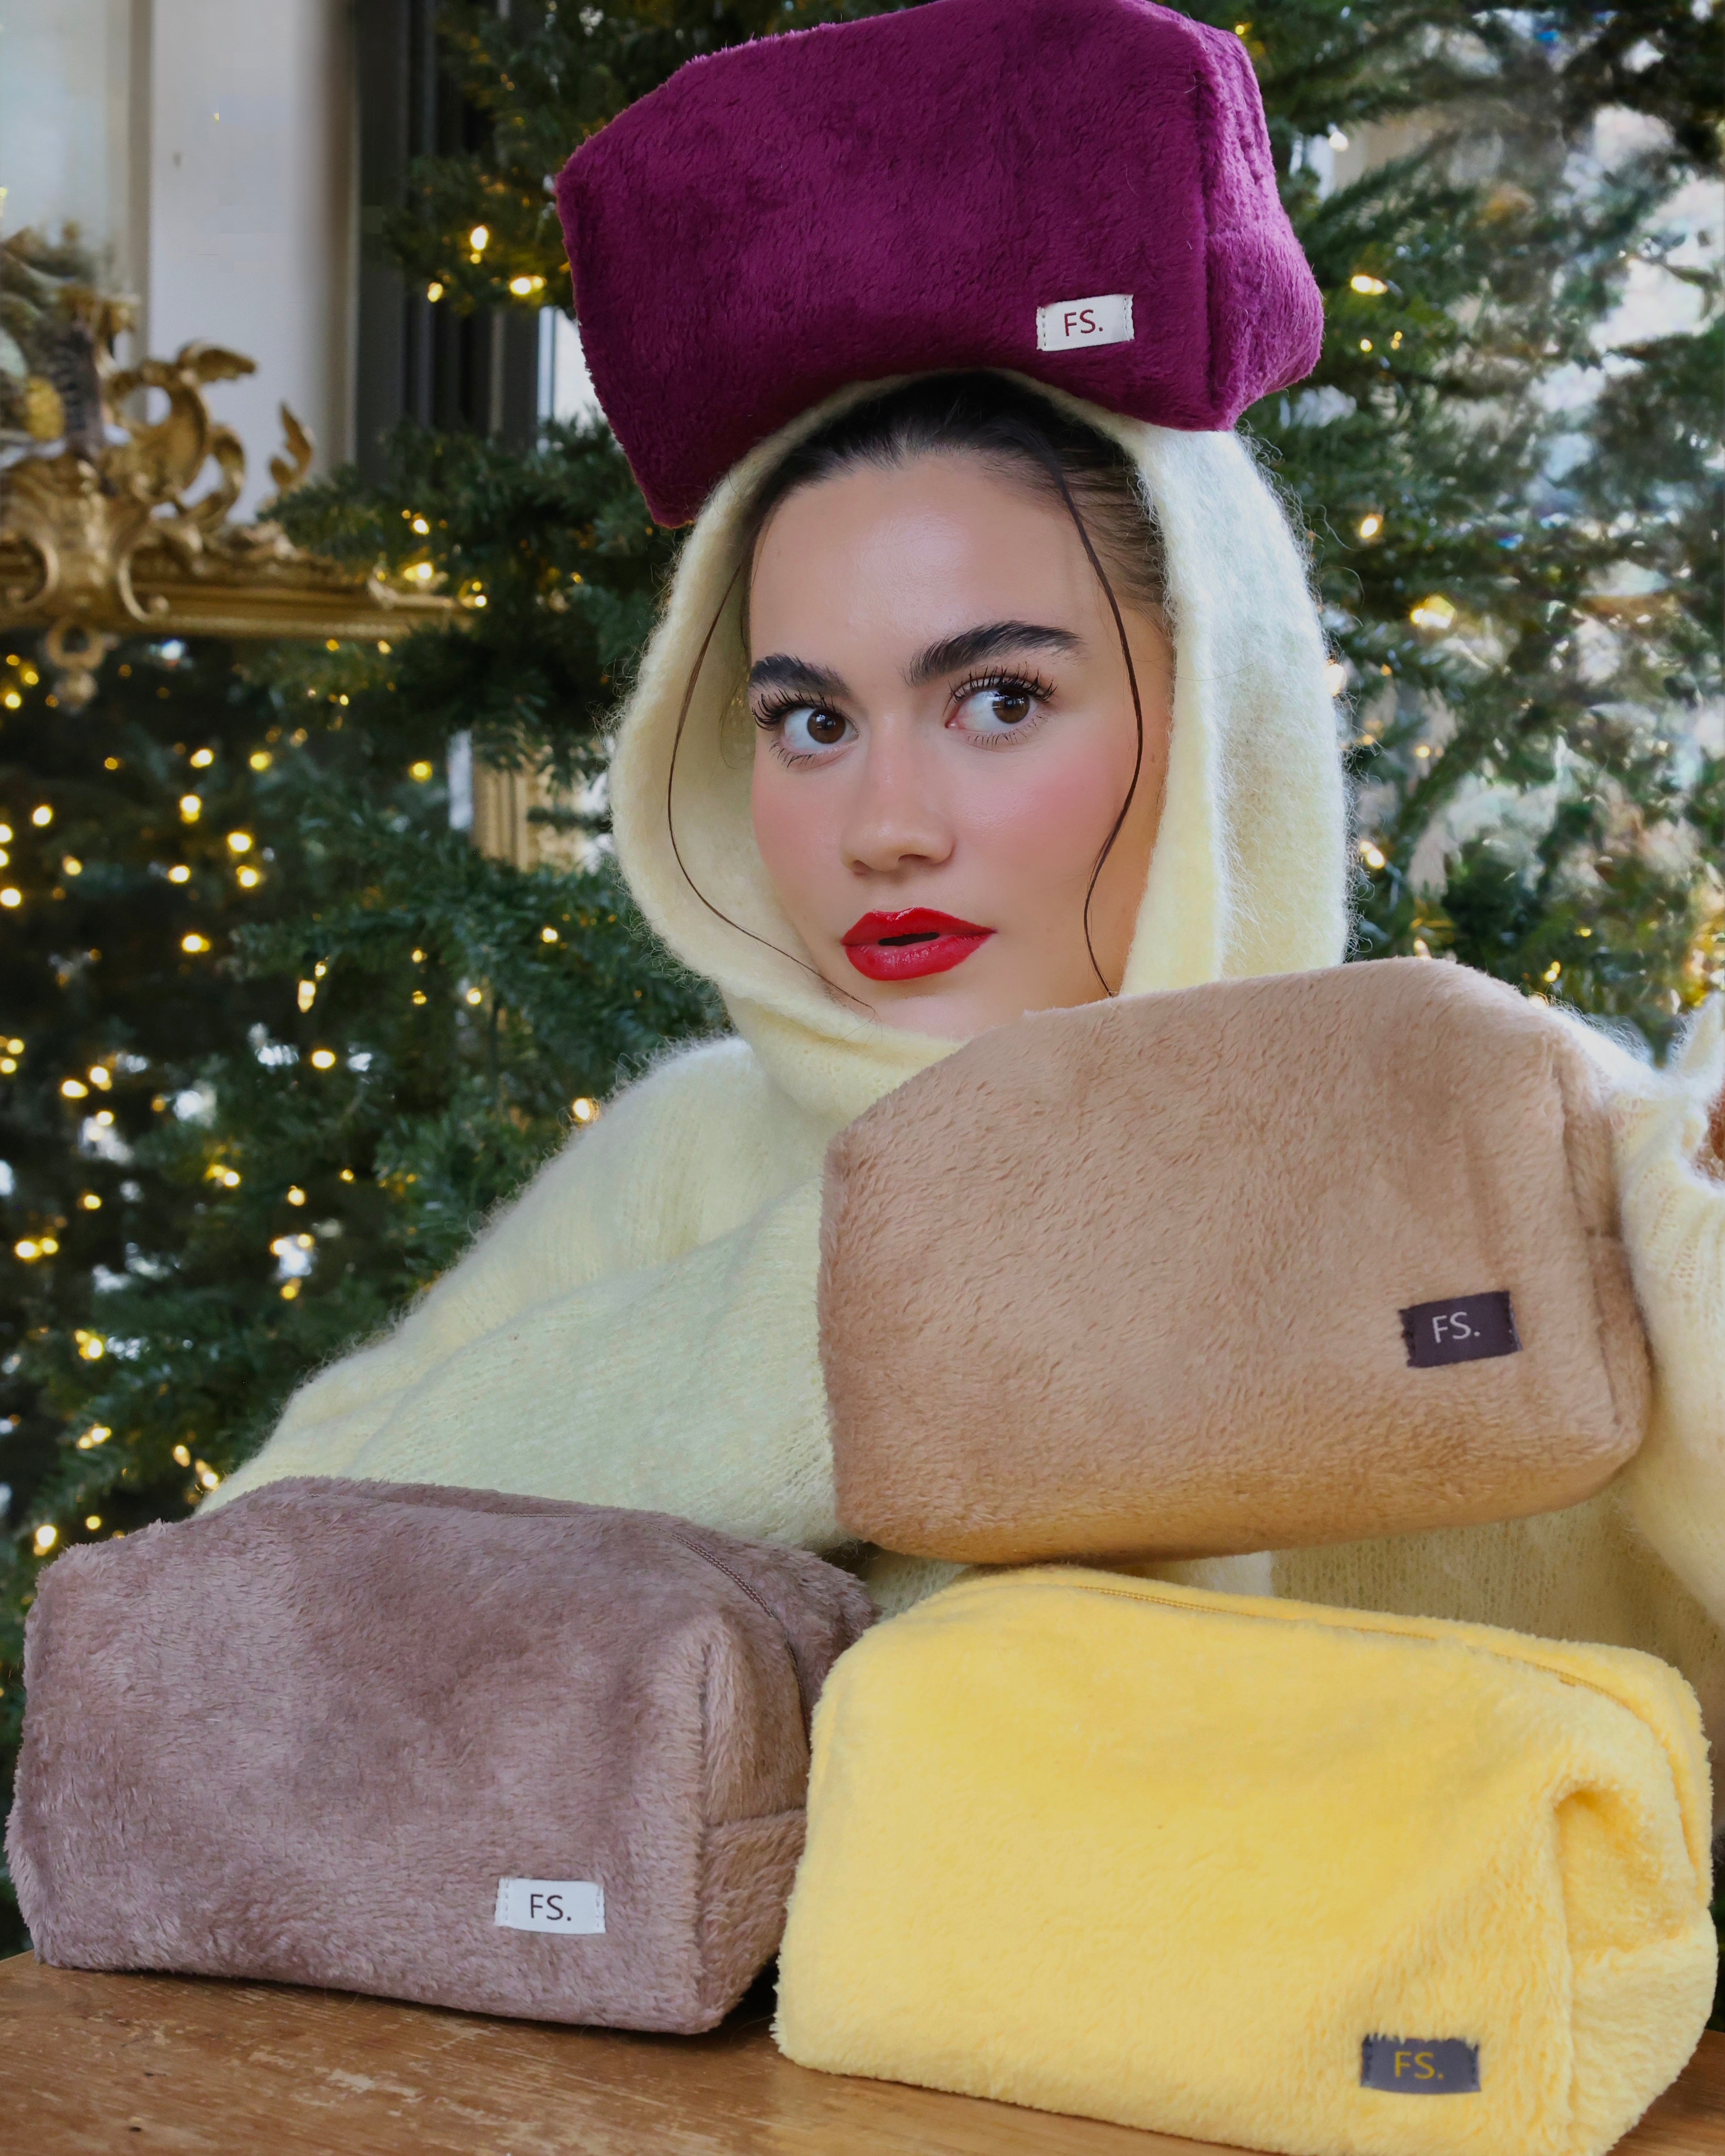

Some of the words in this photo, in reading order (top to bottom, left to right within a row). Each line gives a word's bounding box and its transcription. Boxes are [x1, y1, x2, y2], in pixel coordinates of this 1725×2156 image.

[1065, 309, 1103, 337] FS.
[1432, 1311, 1480, 1344] FS.
[530, 1894, 571, 1921] FS.
[1395, 2051, 1444, 2080] FS.
